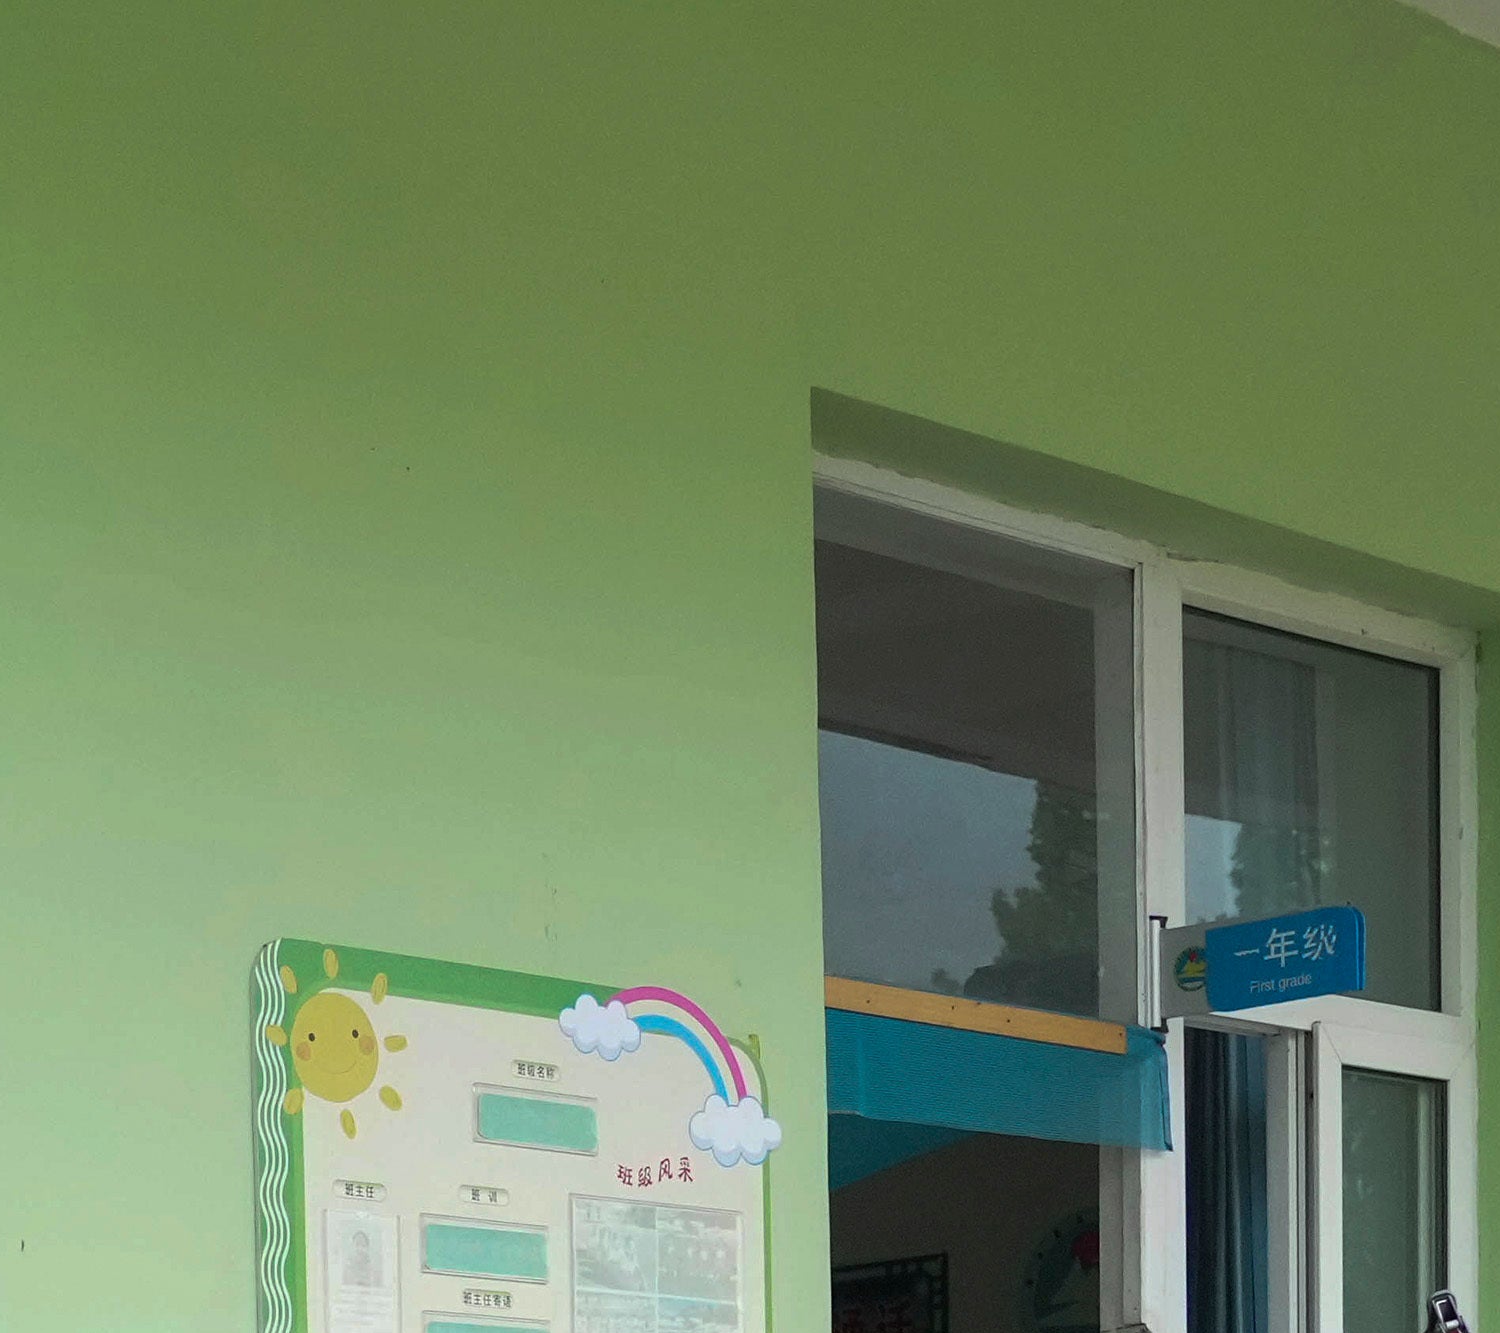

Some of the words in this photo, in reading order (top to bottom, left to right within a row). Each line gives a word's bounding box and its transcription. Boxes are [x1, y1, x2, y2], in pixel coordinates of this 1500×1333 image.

[1233, 924, 1337, 967] 一年级
[1249, 980, 1275, 993] First
[1278, 974, 1312, 992] grade
[518, 1062, 554, 1079] 班级名称
[617, 1157, 694, 1188] 班级风采
[345, 1183, 374, 1198] 班主任
[463, 1291, 511, 1308] 班主任寄语
